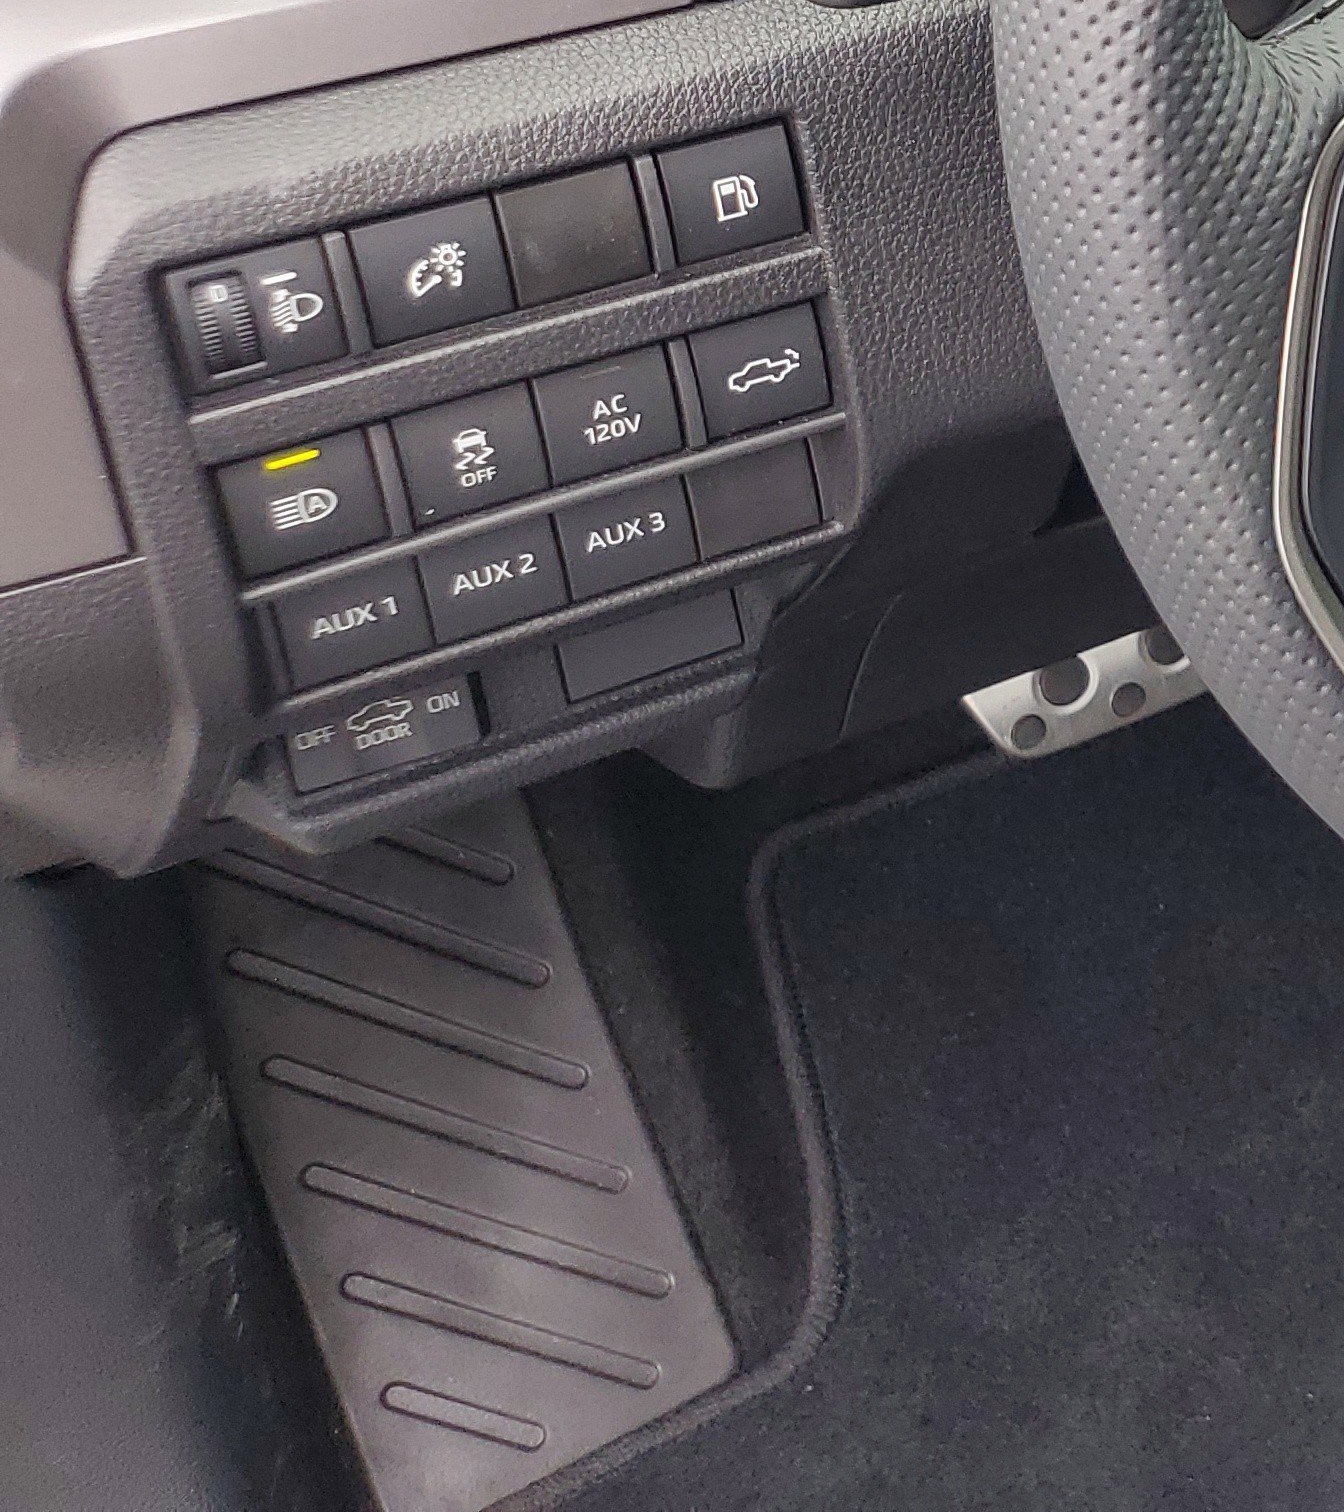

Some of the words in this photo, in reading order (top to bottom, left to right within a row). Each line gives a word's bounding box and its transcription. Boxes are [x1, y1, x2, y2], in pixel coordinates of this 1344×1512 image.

[592, 394, 627, 420] AC
[583, 414, 642, 445] 120V
[460, 465, 497, 488] OFF
[586, 519, 643, 553] AUX
[646, 511, 666, 535] 3
[452, 562, 512, 596] AUX
[517, 553, 538, 577] 2
[311, 603, 380, 639] AUX
[383, 595, 399, 619] 1
[296, 724, 337, 751] OFF
[426, 690, 461, 714] ON
[355, 722, 413, 751] DOOR
